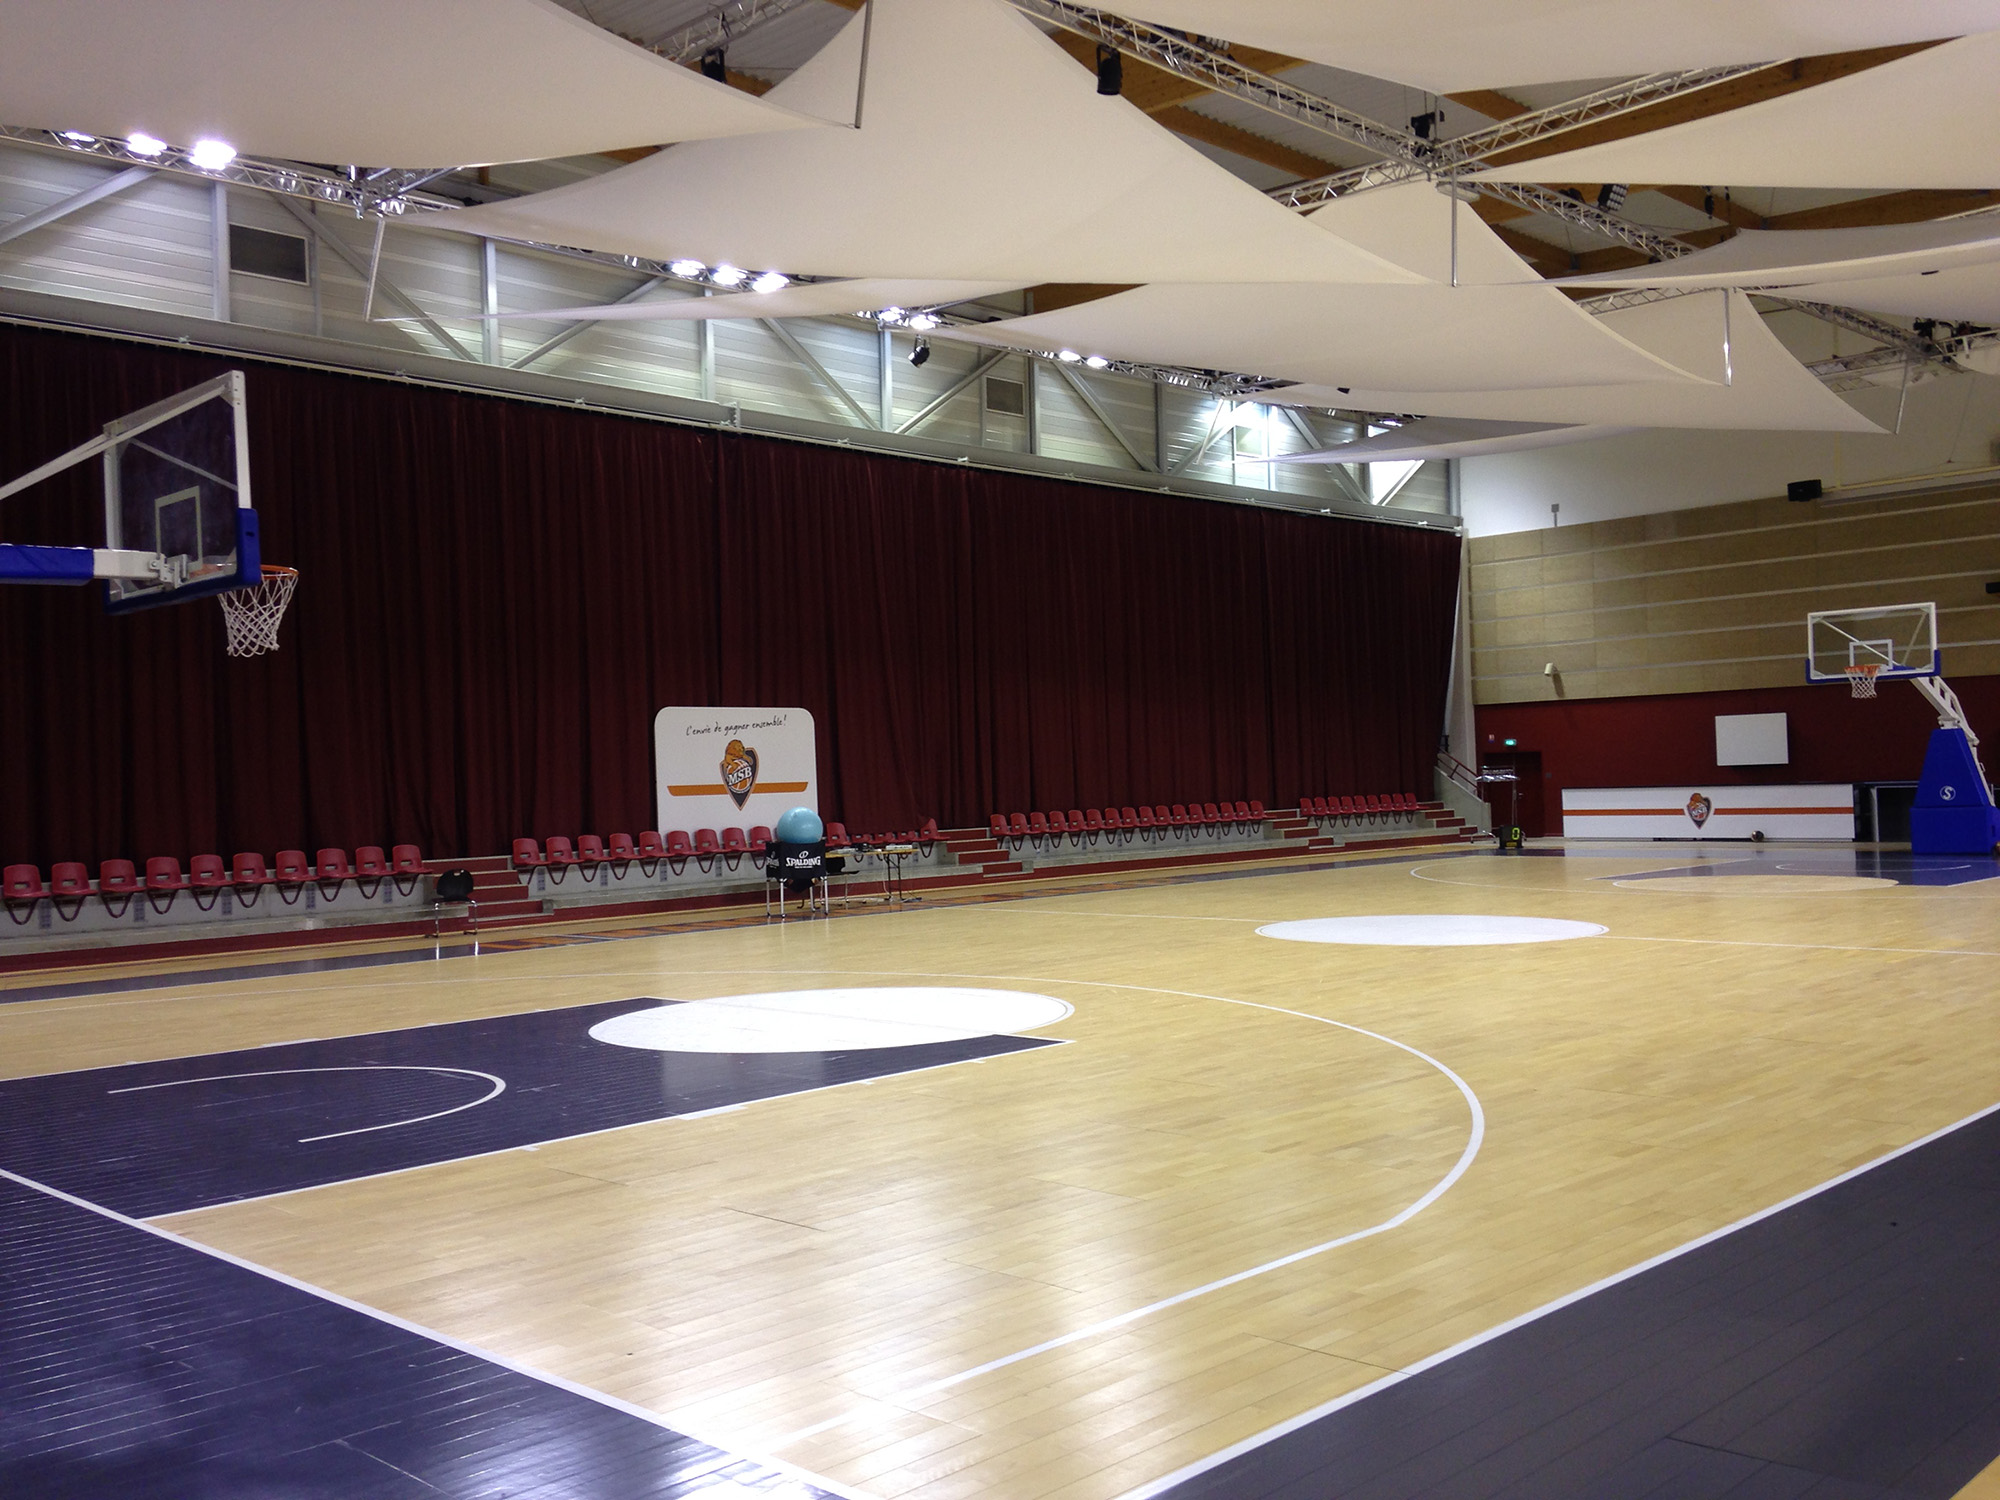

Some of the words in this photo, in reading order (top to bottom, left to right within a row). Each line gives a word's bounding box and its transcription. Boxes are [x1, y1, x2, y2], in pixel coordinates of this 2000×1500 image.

[714, 721, 722, 733] de
[724, 723, 750, 736] gagner
[752, 714, 787, 729] ensemble!
[727, 766, 753, 786] MSB
[785, 856, 821, 867] SPALDING
